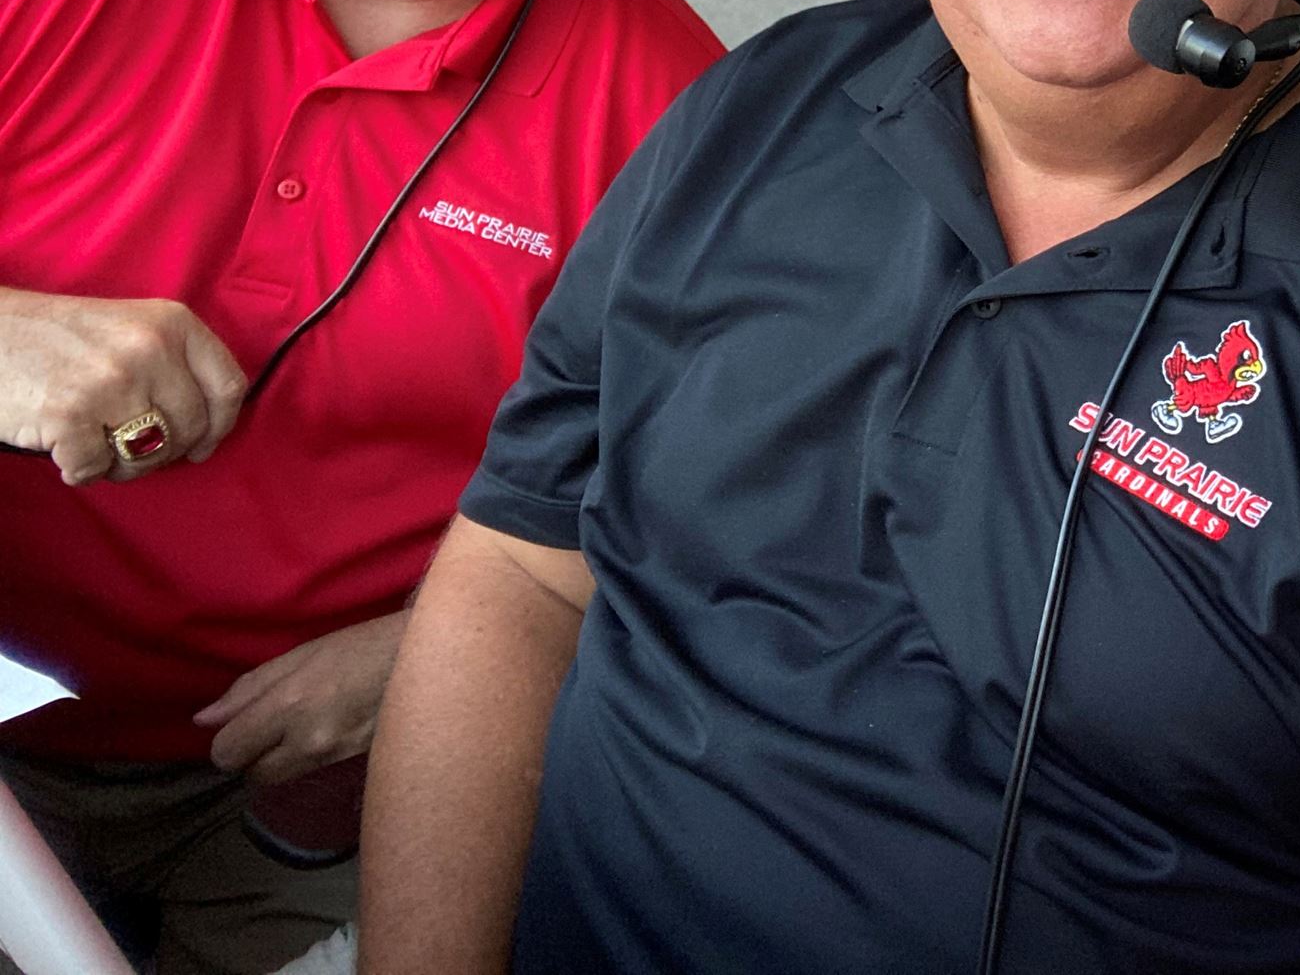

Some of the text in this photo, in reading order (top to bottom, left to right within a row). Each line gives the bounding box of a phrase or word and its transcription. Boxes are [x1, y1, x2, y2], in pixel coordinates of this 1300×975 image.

[418, 207, 552, 259] MEDIA CENTER
[433, 200, 549, 246] SUN PRAIRIE
[1069, 402, 1273, 528] SUN PRAIRIE
